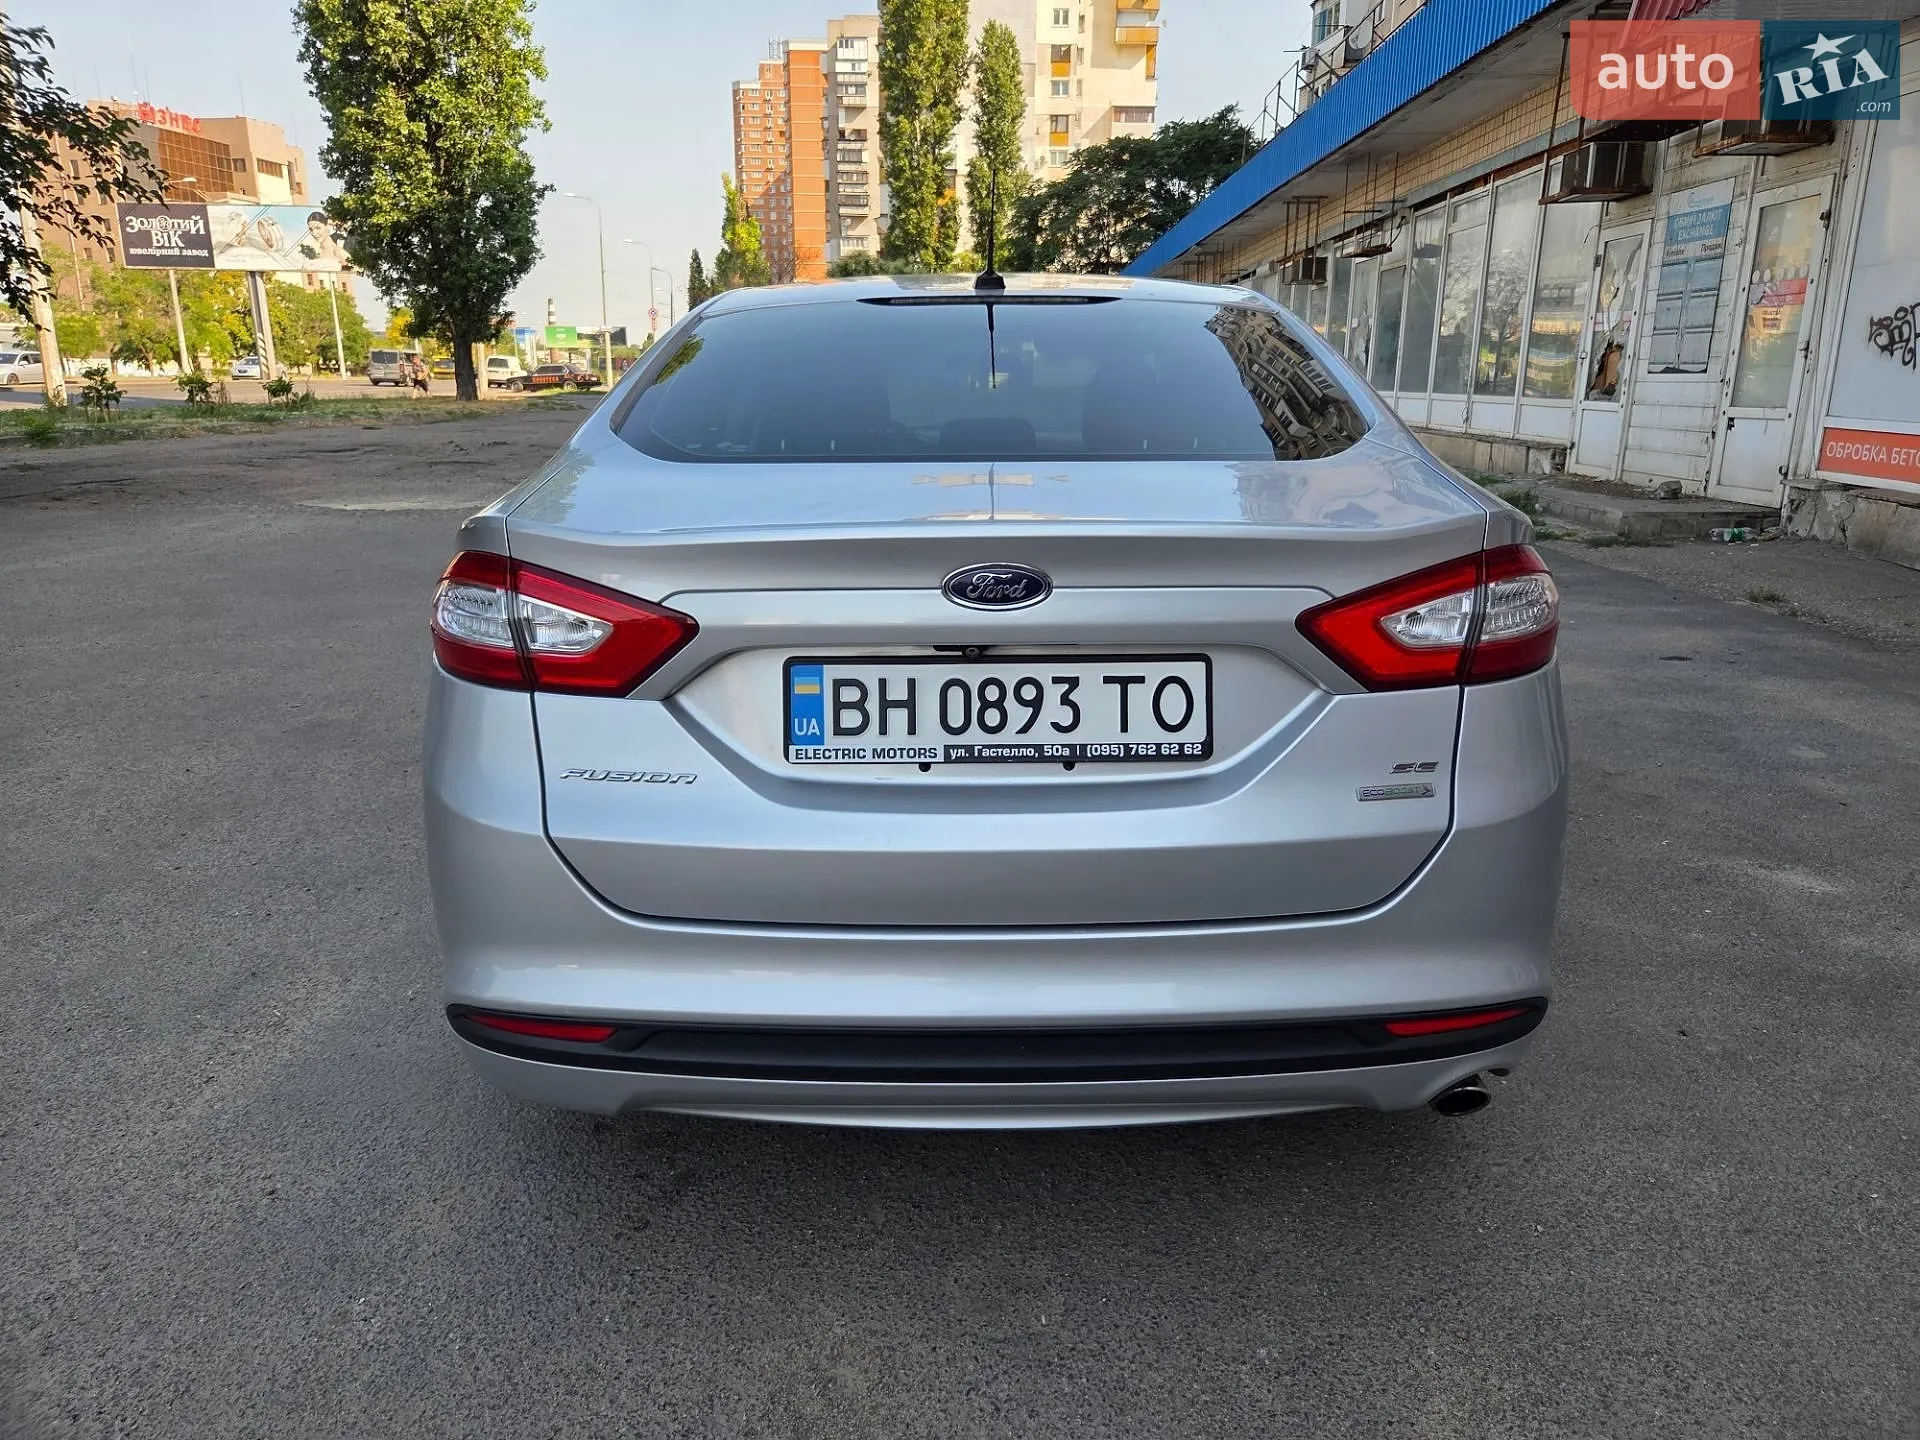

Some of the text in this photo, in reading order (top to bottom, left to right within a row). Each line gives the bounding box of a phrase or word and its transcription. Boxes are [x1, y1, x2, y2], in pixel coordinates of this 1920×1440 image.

[182, 248, 209, 257] завод
[1826, 441, 1887, 462] ОБРОБКА
[966, 573, 1028, 599] Ford
[832, 674, 1195, 737] BH 0893 TO
[794, 718, 820, 736] UA
[795, 746, 938, 761] ELECTRIC MOTORS
[949, 747, 970, 760] ул.
[974, 744, 1041, 759] Гастелло,
[1086, 743, 1125, 757] (095)
[1129, 743, 1157, 757] 762
[1161, 743, 1181, 756] 62
[1183, 742, 1203, 756] 62
[1390, 760, 1440, 774] SE
[560, 768, 699, 785] FUSION
